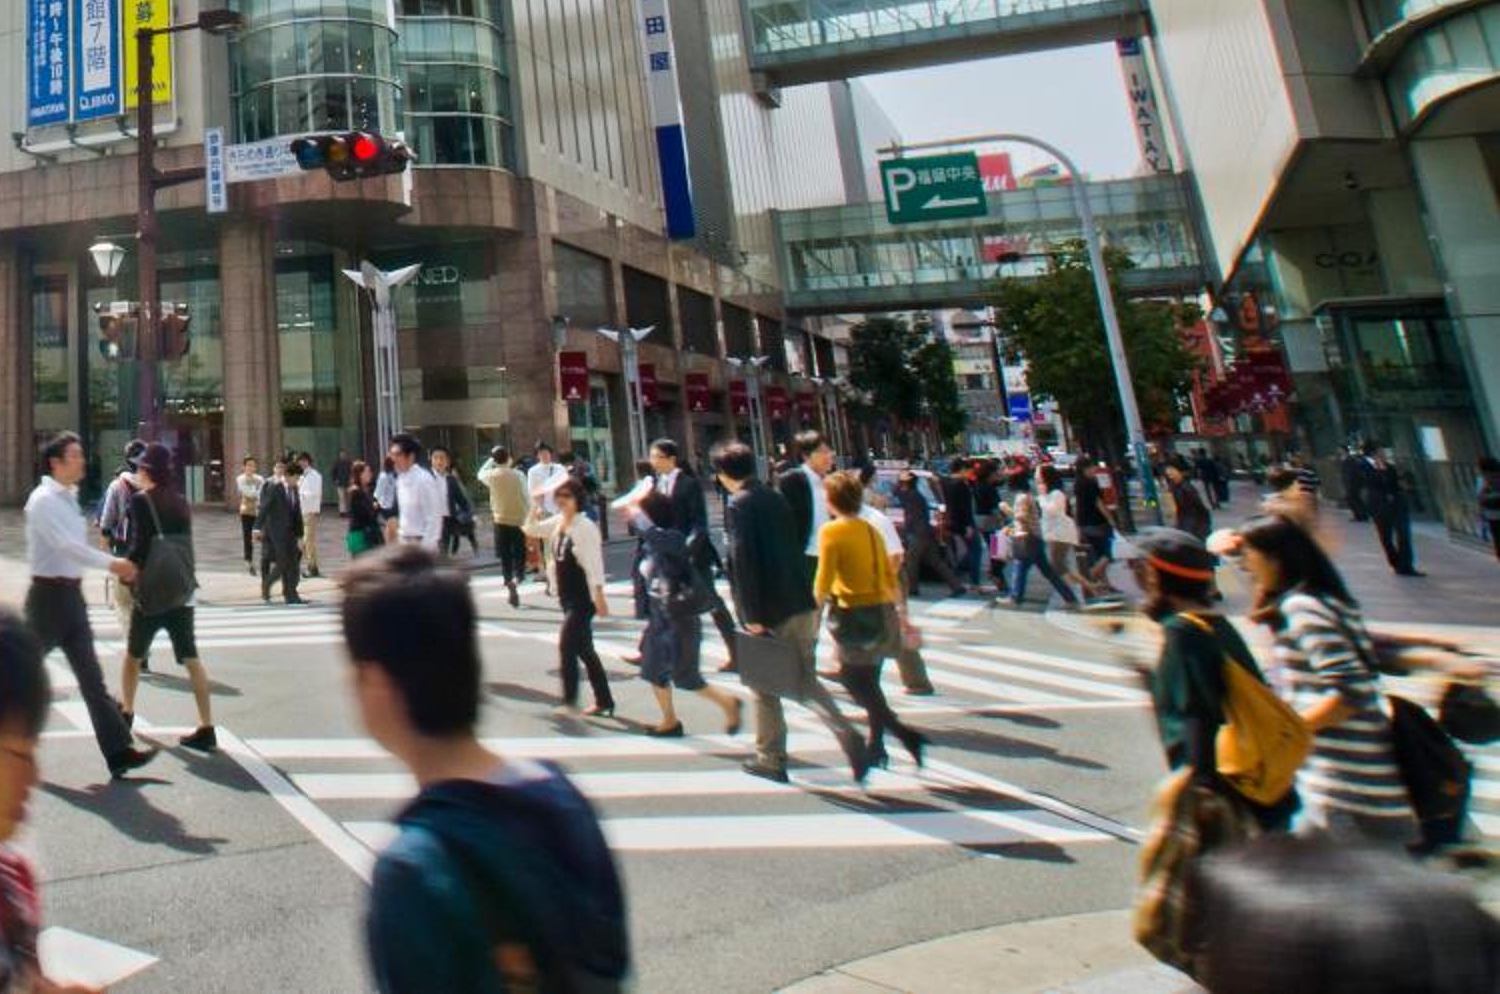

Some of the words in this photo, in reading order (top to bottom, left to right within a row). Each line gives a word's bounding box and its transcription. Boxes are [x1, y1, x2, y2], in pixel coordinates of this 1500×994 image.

[886, 167, 917, 212] P
[916, 165, 978, 186] 福岡中央
